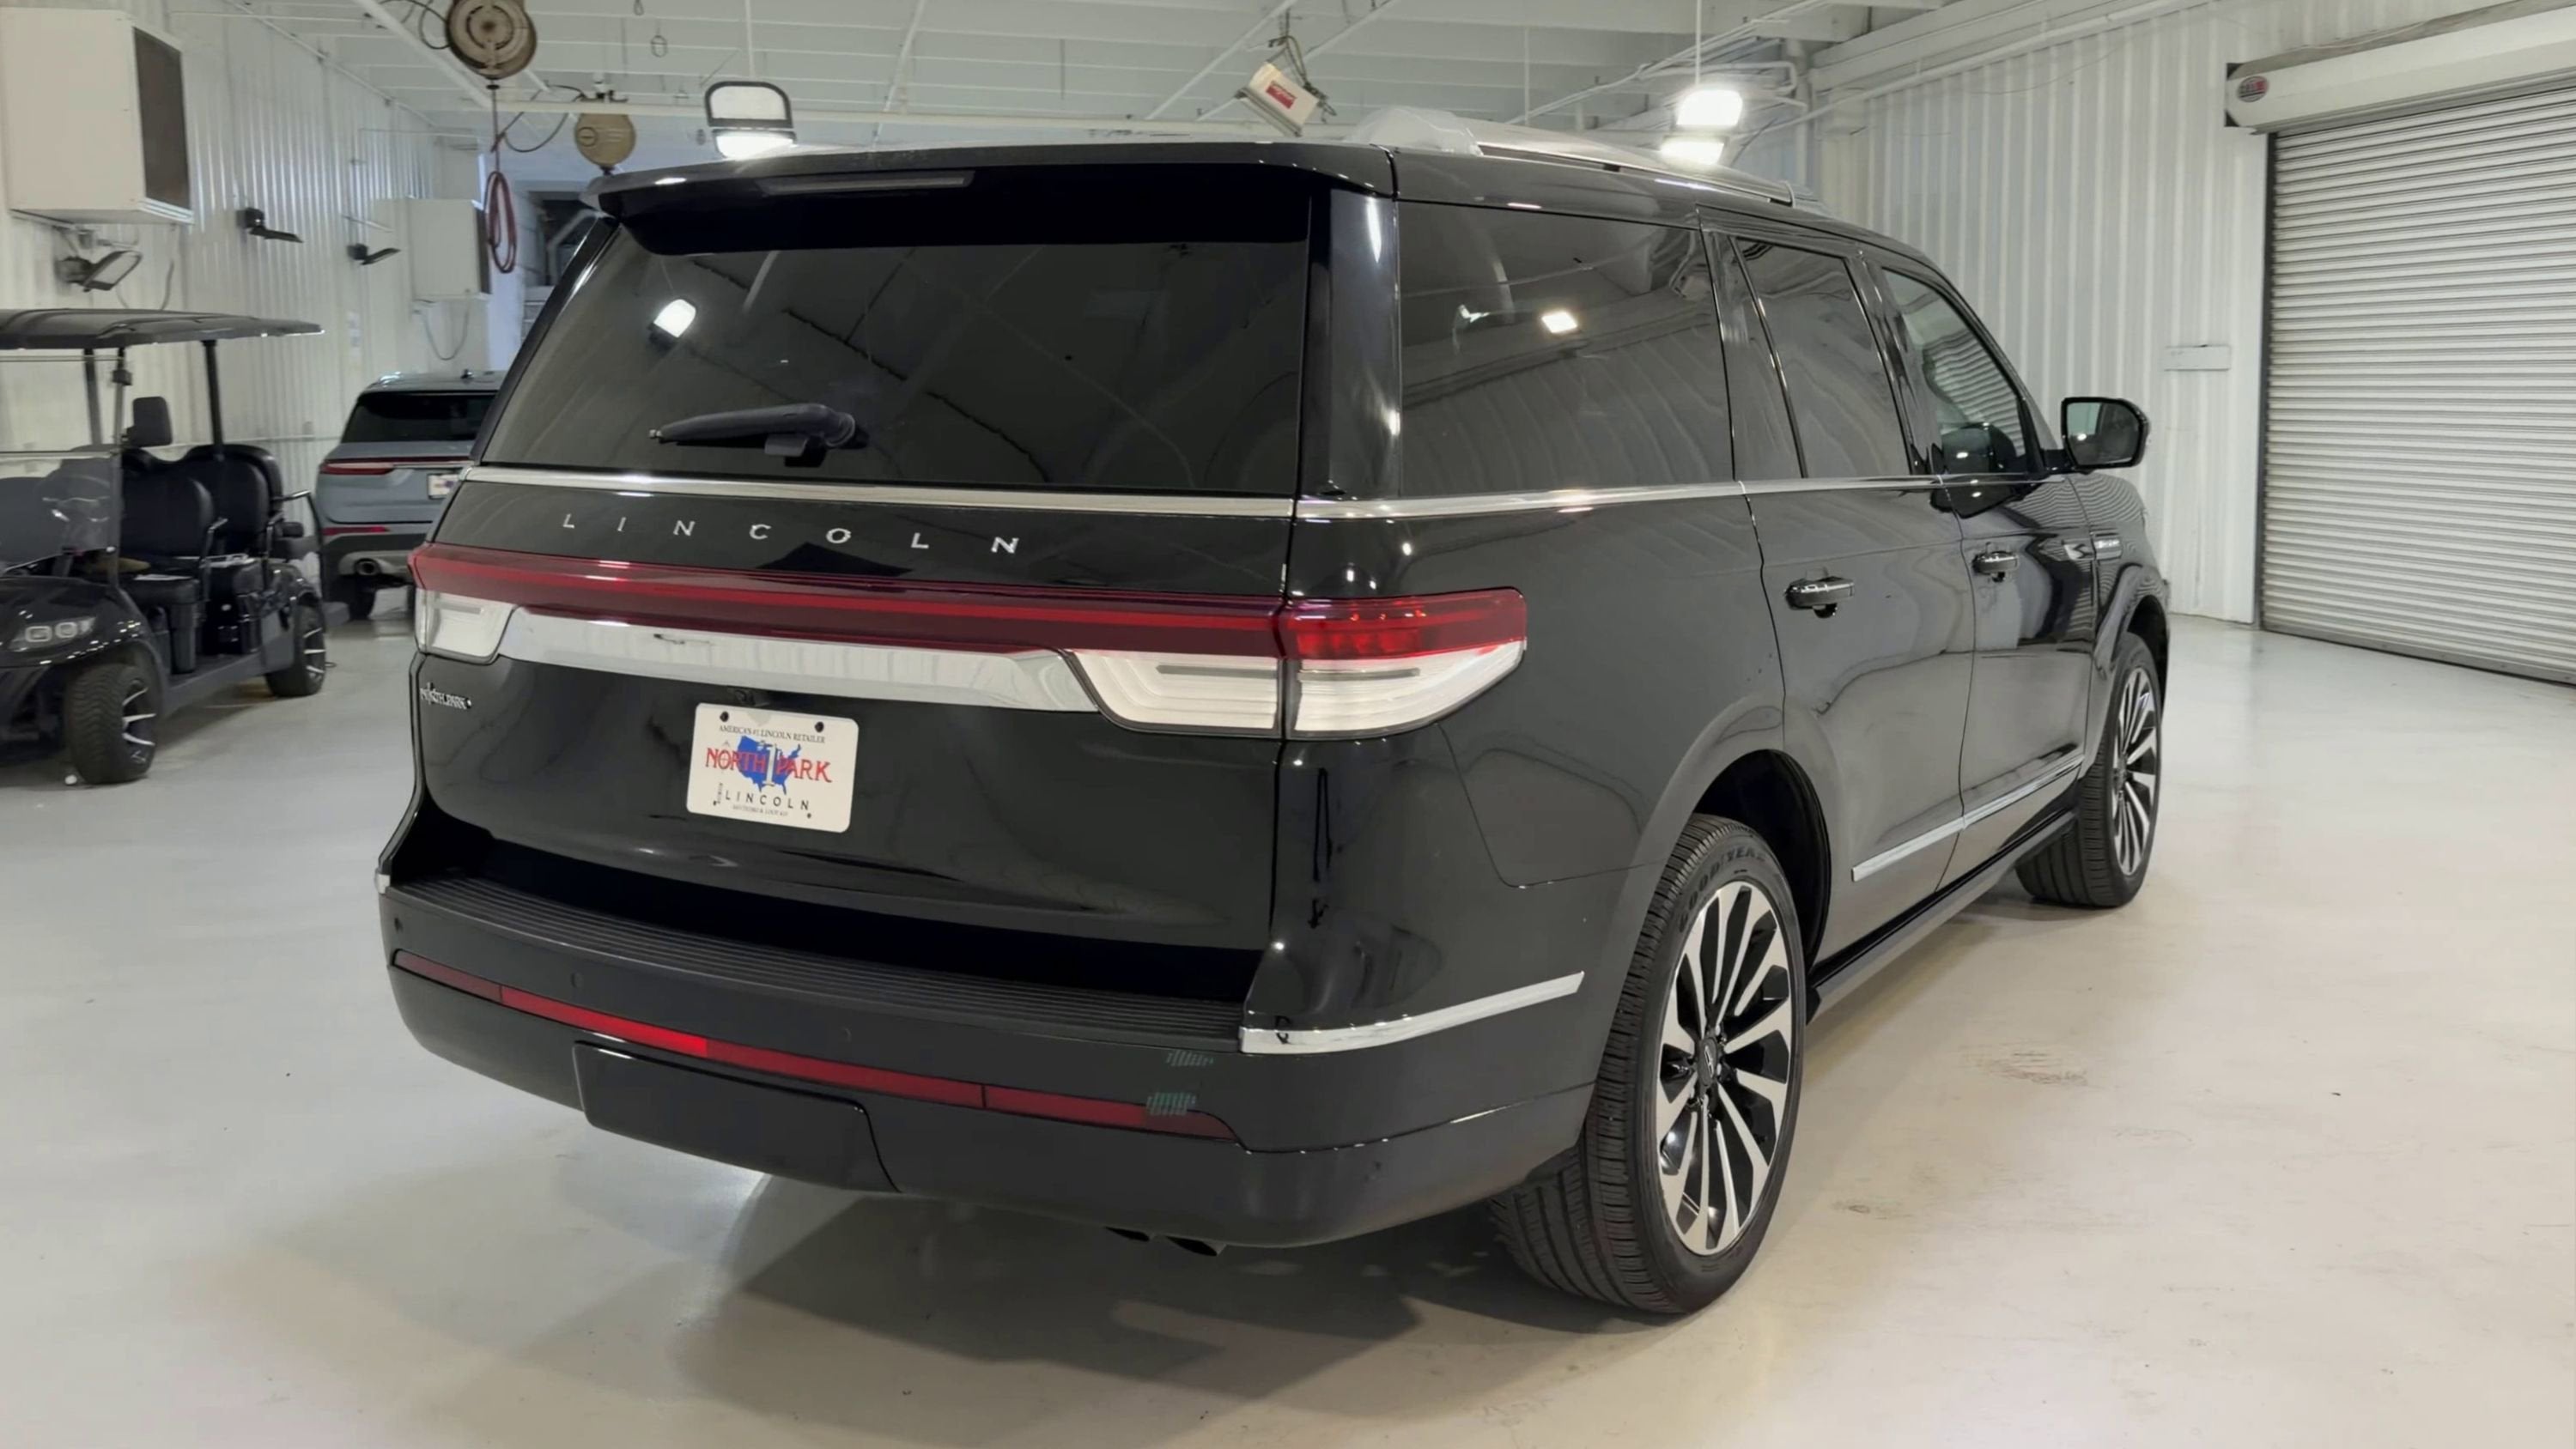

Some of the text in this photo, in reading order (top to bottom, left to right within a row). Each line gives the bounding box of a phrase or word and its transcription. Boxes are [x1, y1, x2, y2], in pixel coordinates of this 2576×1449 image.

[563, 514, 1020, 554] LINCOLN
[761, 729, 792, 740] LINCOLN
[793, 733, 825, 744] RETAILER
[705, 747, 766, 773] NORTH
[776, 755, 833, 783] PARK
[725, 790, 809, 811] LINCOLN
